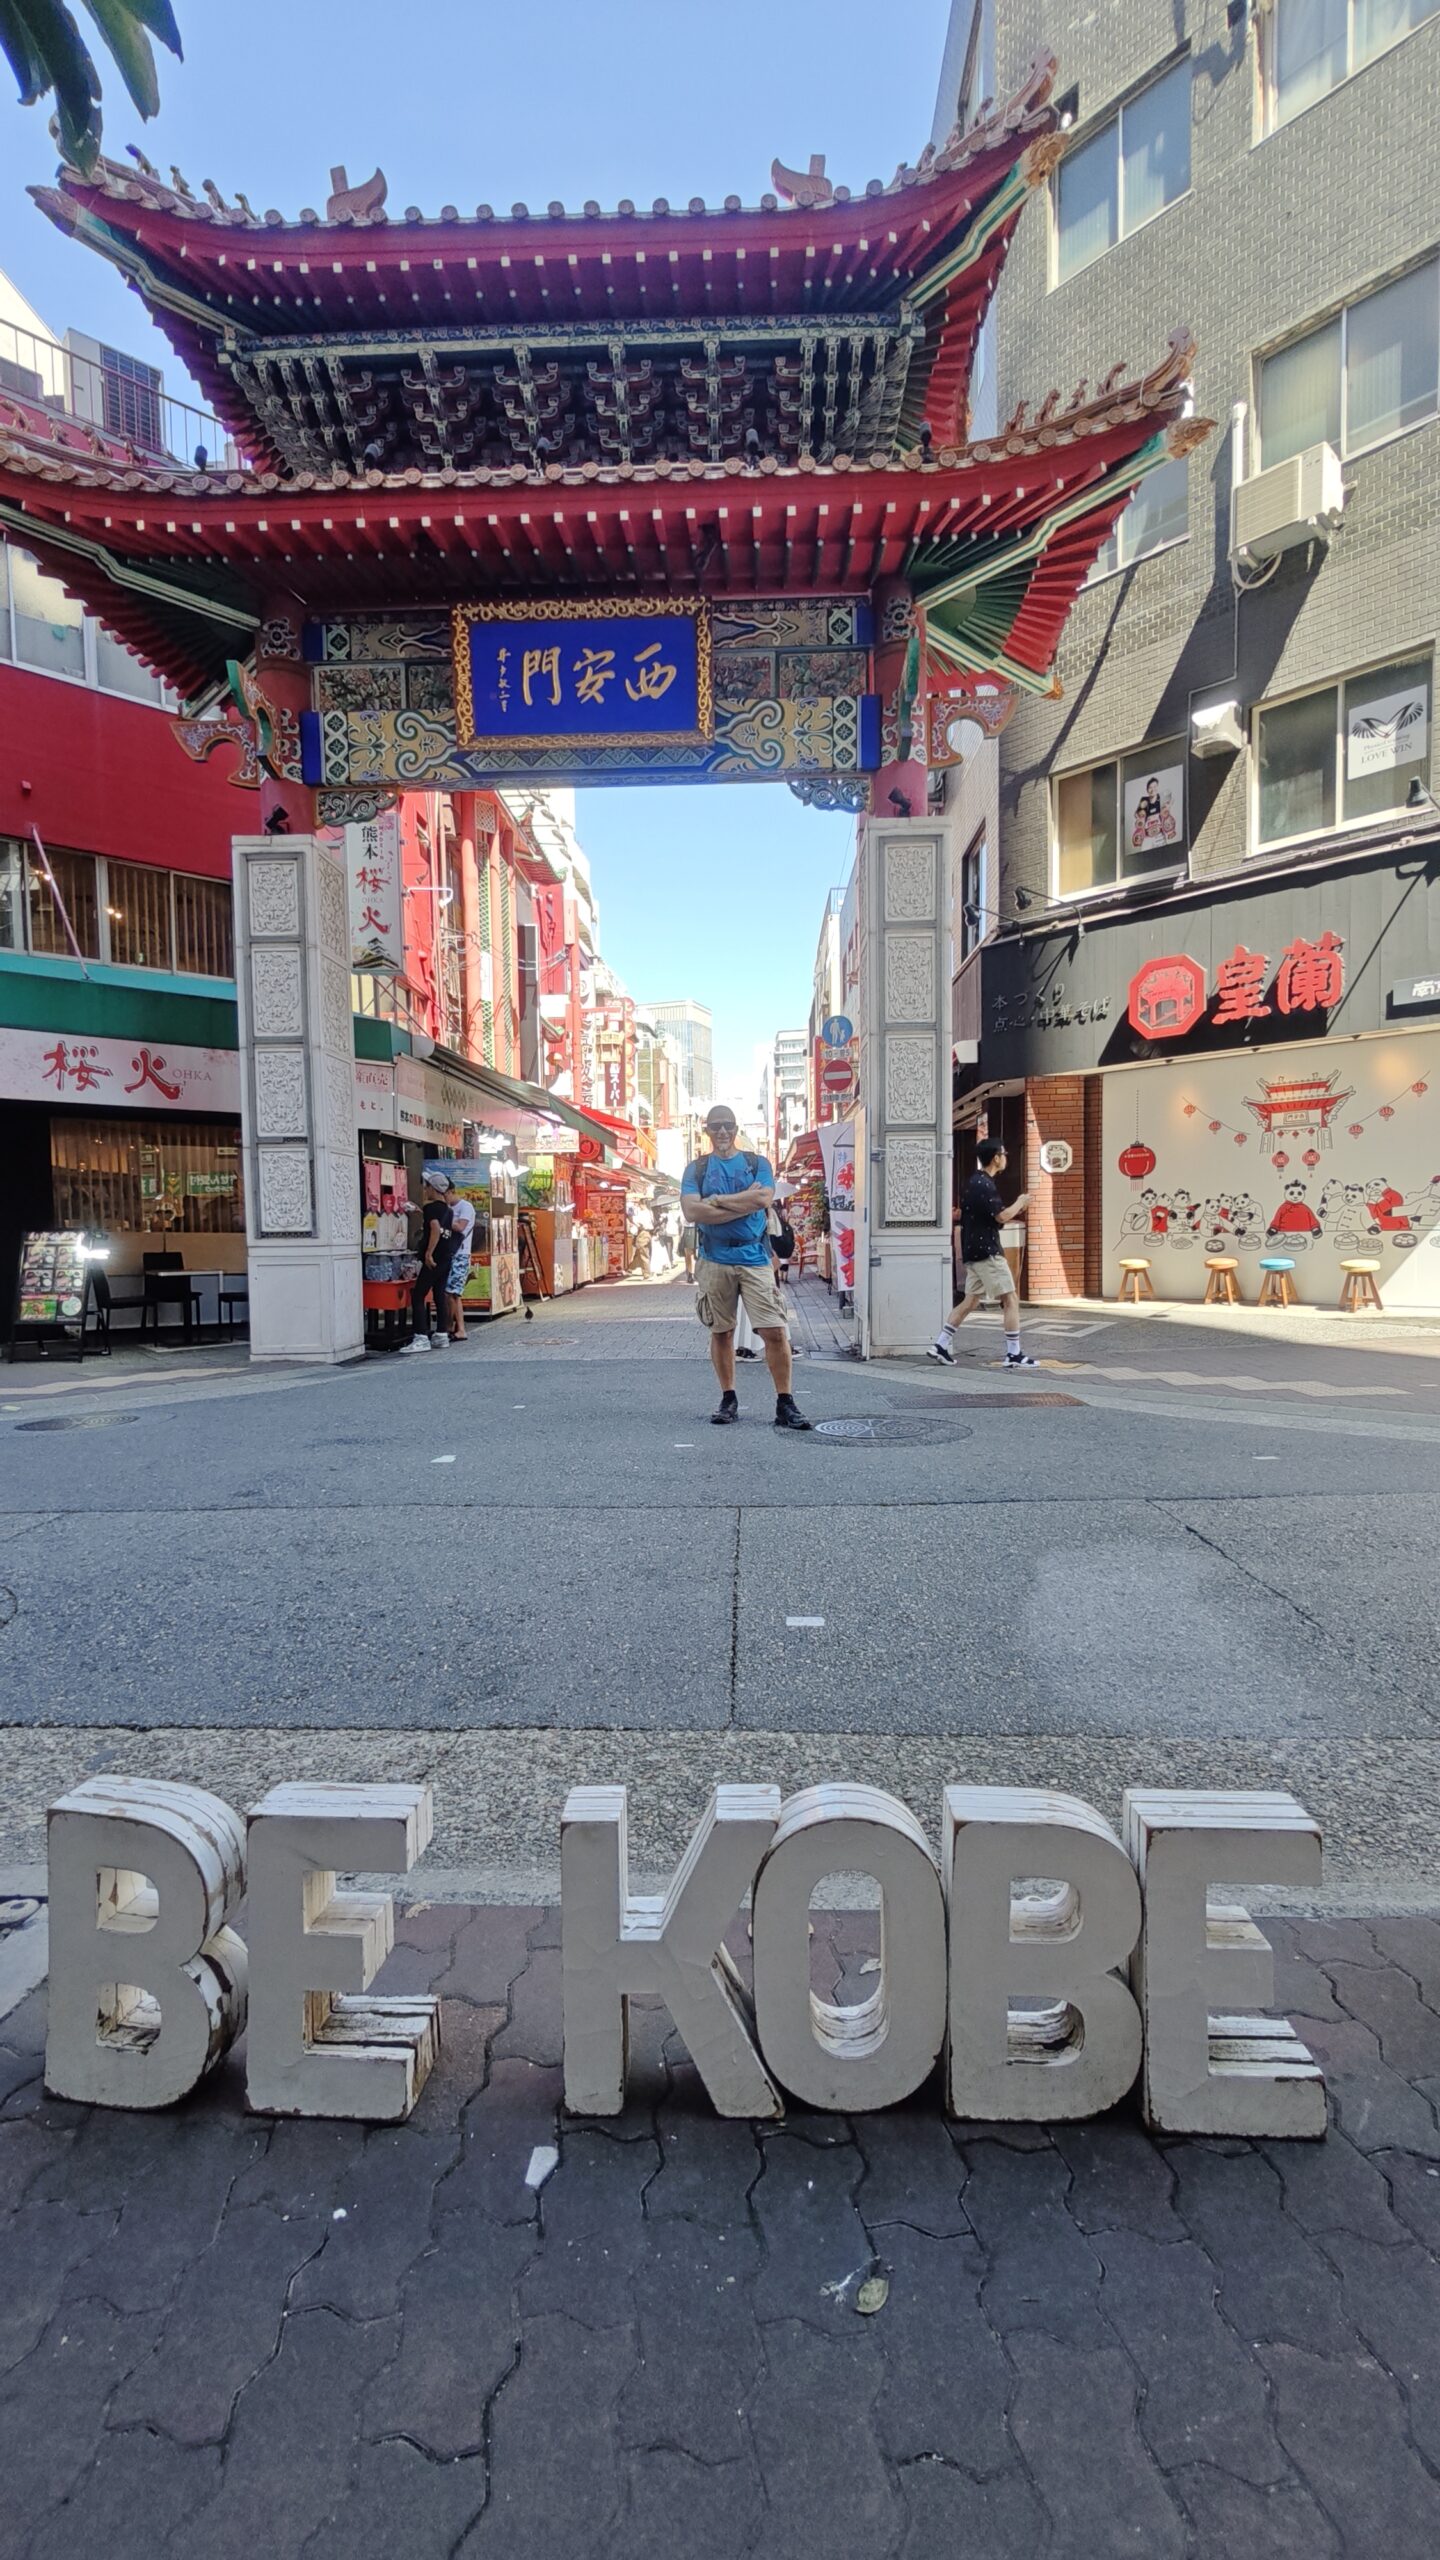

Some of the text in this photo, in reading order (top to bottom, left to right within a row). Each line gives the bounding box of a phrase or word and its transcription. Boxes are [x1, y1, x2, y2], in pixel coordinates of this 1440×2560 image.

[1391, 741, 1413, 755] WIN
[361, 825, 379, 860] 熊本
[1211, 929, 1347, 1025] 皇蘭
[42, 1040, 213, 1101] 桜火 OHKA
[44, 1774, 1328, 2138] BE KOBE
